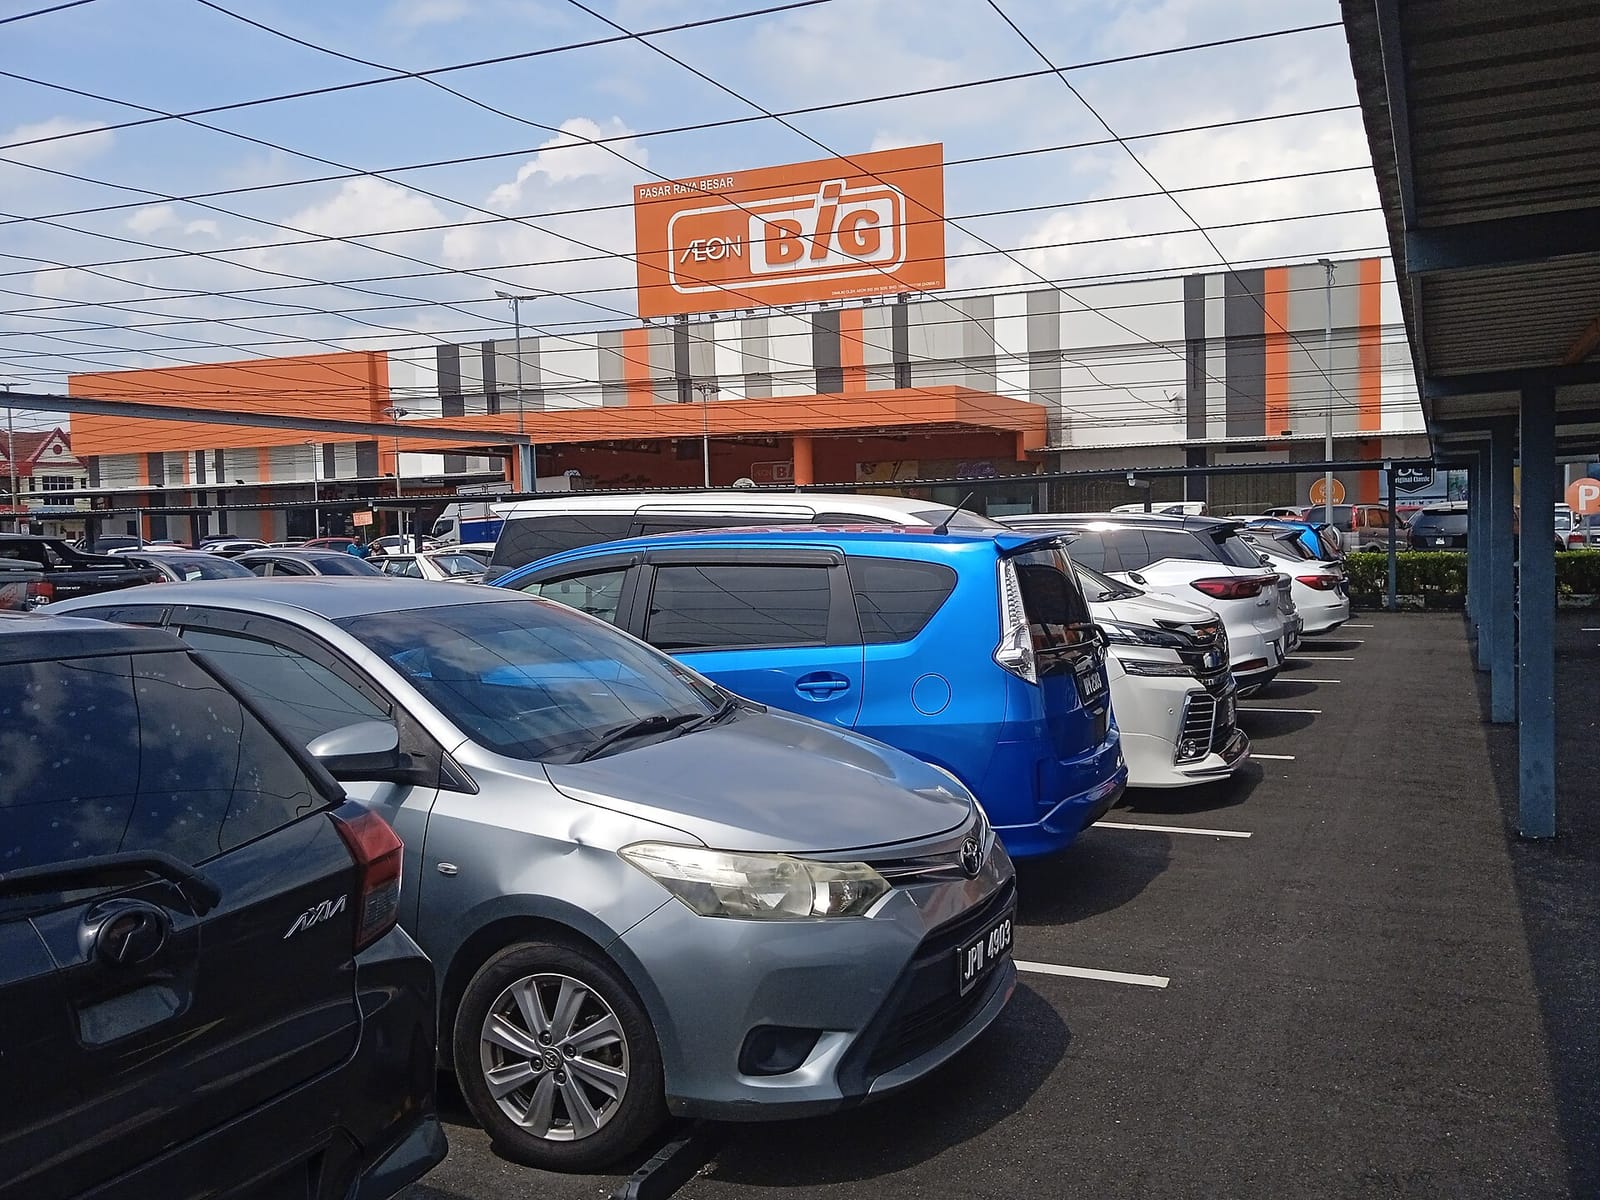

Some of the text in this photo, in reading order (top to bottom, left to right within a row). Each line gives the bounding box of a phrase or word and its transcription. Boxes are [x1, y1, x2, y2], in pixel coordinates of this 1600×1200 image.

[639, 176, 734, 200] PASAR RAYA BESAR
[1579, 485, 1600, 511] P
[987, 919, 1011, 959] 4903
